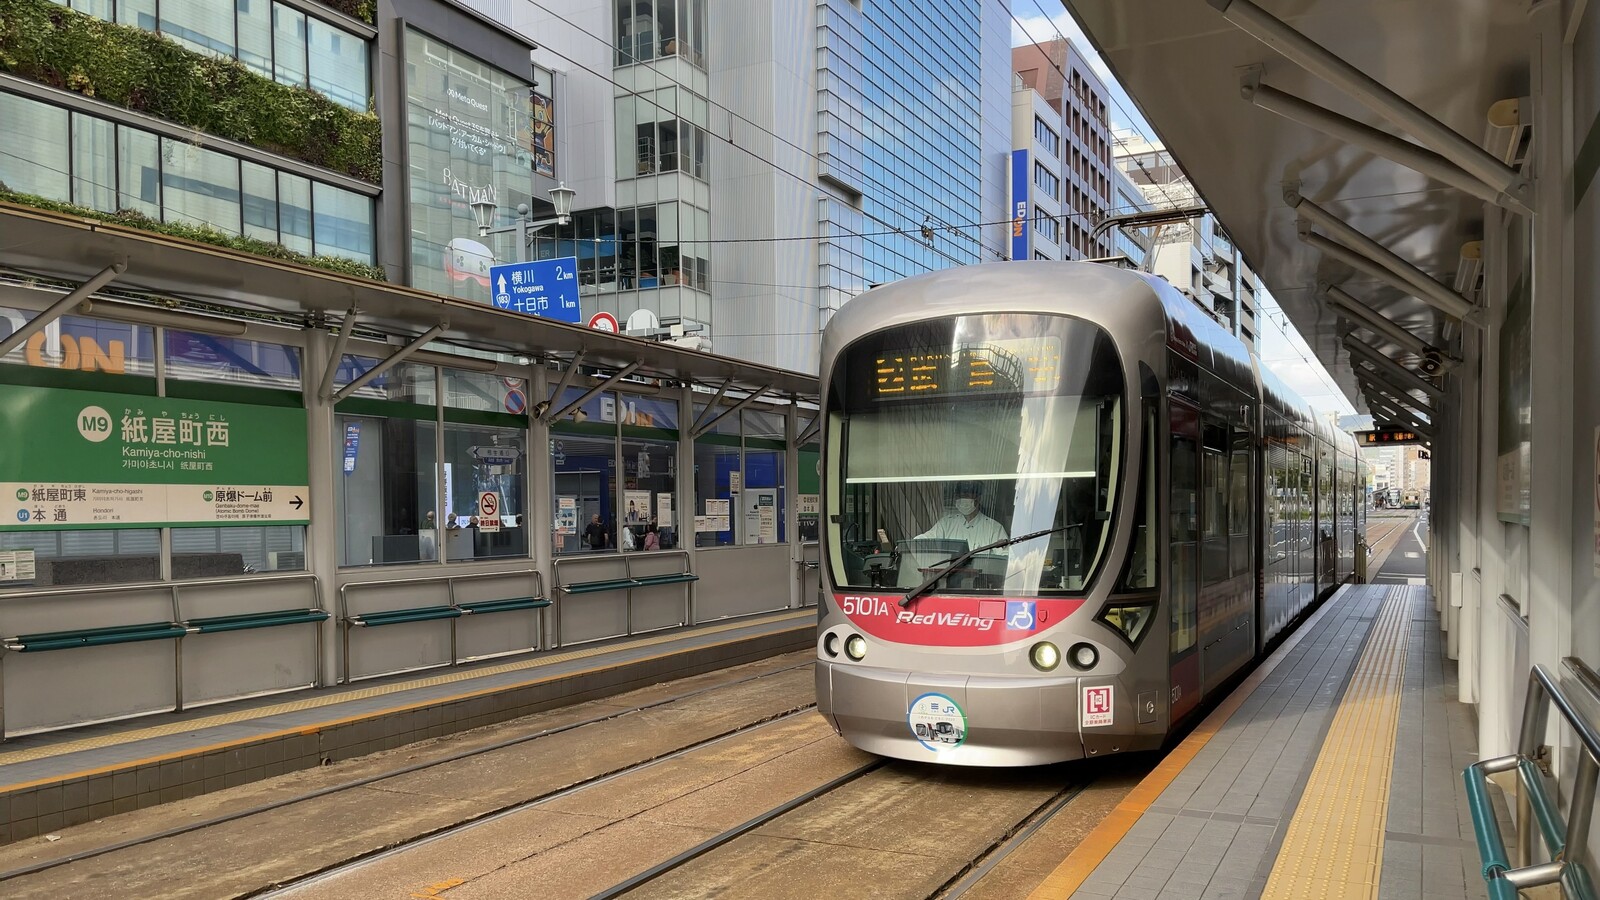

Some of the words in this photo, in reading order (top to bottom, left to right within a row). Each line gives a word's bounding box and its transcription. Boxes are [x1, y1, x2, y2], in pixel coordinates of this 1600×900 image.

[455, 91, 471, 105] Meta
[470, 98, 488, 112] Quest
[511, 269, 535, 285] 横川
[555, 265, 563, 281] 2
[563, 271, 574, 280] km
[512, 284, 544, 294] Yokogawa
[513, 296, 549, 312] 十日市
[82, 415, 109, 432] M9
[121, 415, 230, 447] 紙屋町西
[122, 446, 206, 459] Kamiya-cho-nishi
[32, 488, 87, 502] 紙屋町東
[215, 490, 273, 503] 原爆ドーム前
[843, 597, 889, 616] 5101A
